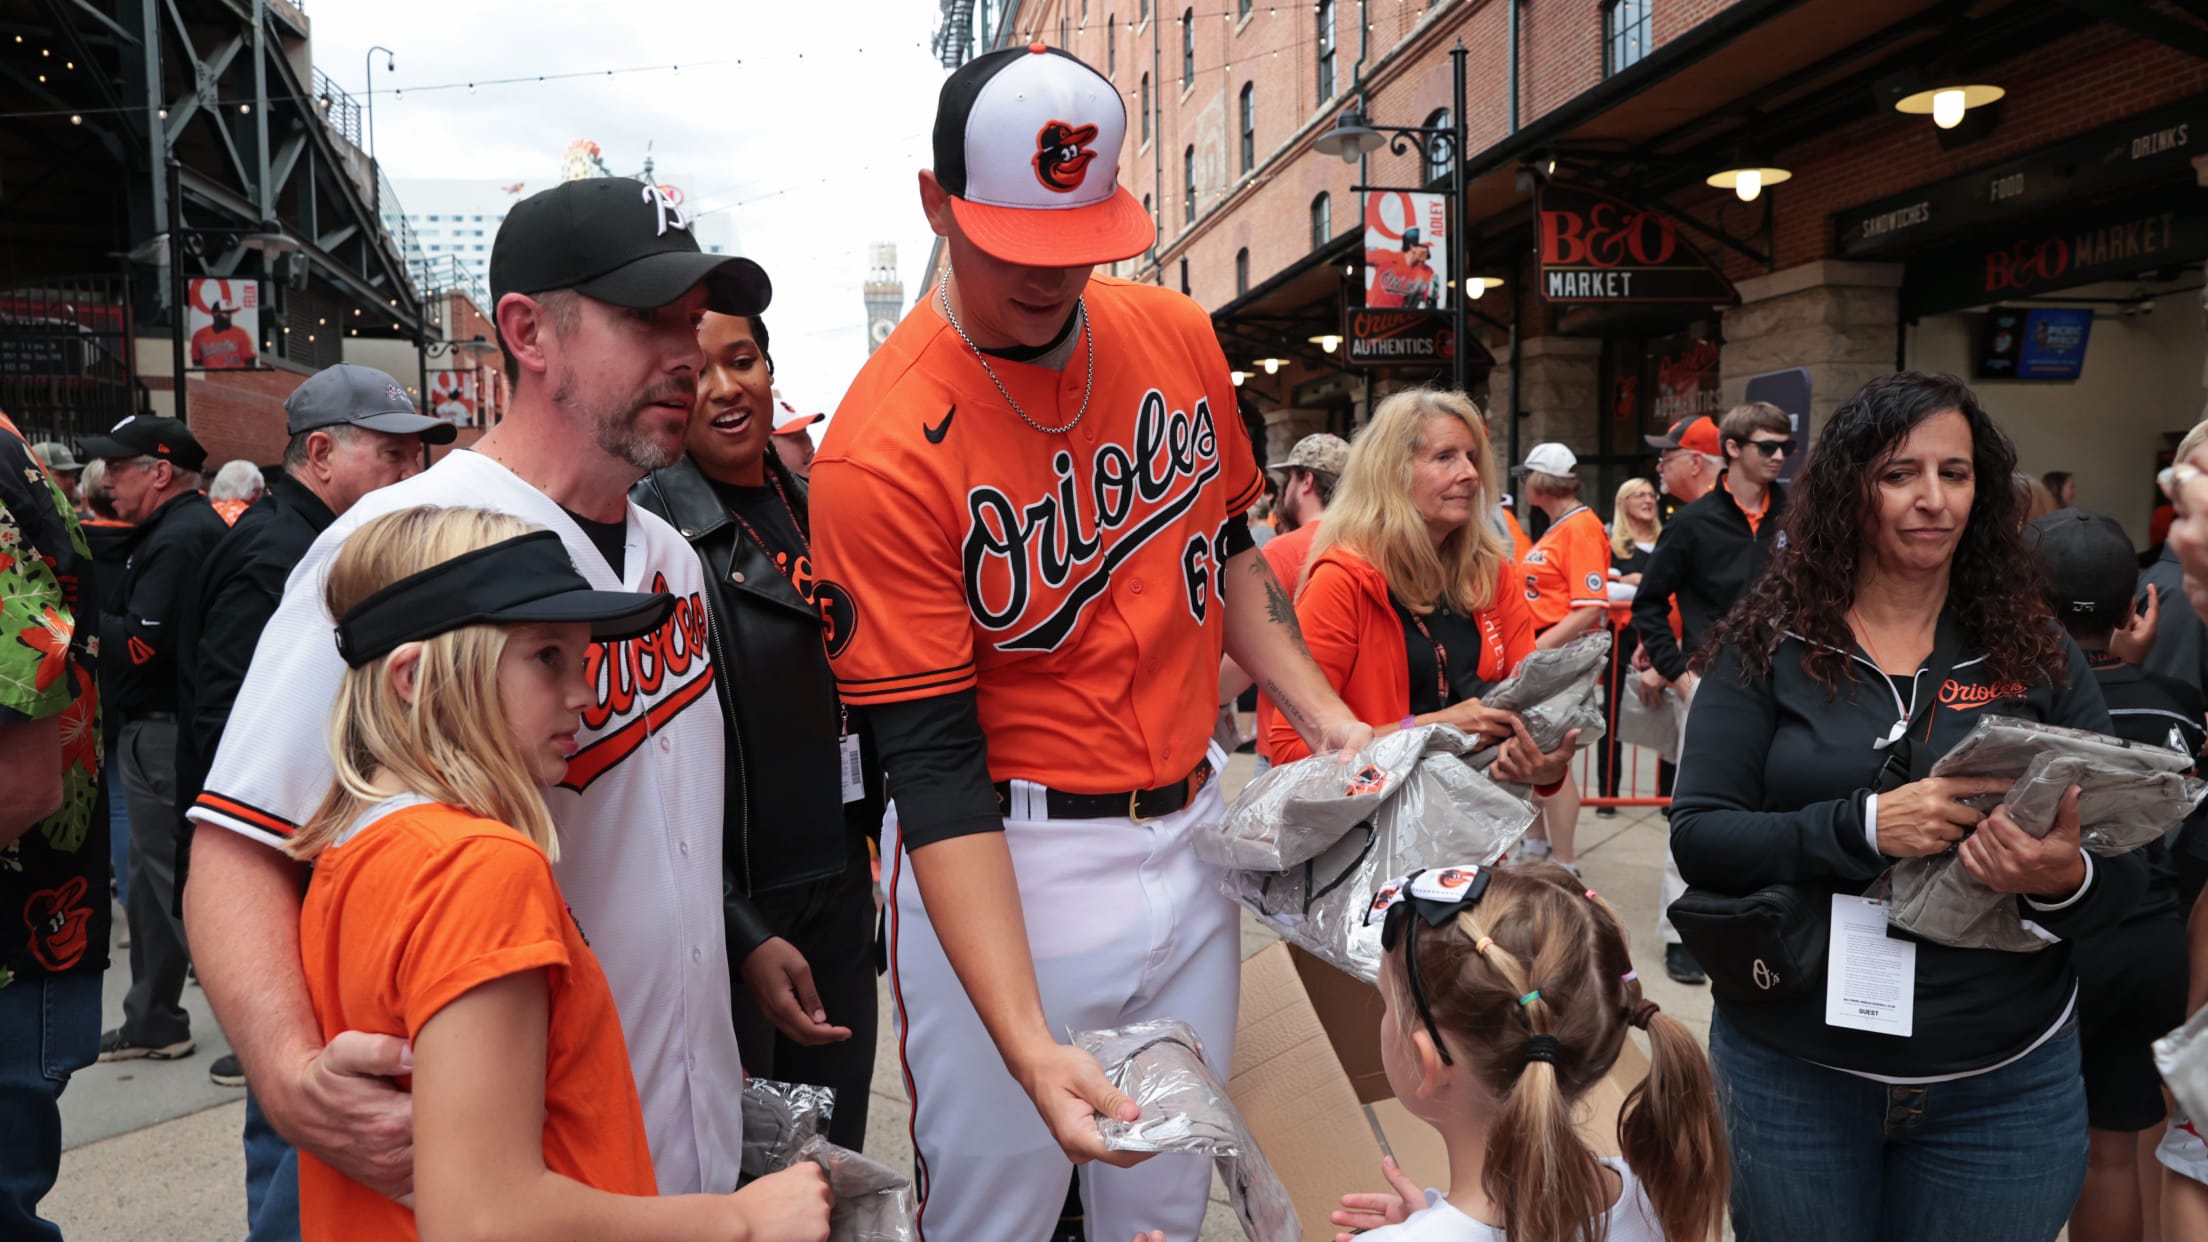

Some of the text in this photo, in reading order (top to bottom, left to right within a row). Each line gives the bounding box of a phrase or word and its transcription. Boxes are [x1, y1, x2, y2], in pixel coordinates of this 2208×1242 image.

[2131, 124, 2189, 160] DRINKS
[1990, 173, 2024, 202] FOOD
[1430, 200, 1444, 237] ADLEY
[1540, 203, 1678, 268] B&O
[1862, 202, 1929, 238] SANDWICHES
[1984, 212, 2175, 292] B&O MARKET
[1549, 272, 1632, 297] MARKET
[1353, 337, 1435, 355] AUTHENTICS
[962, 388, 1220, 632] Orioles
[1938, 678, 2028, 704] Orioles
